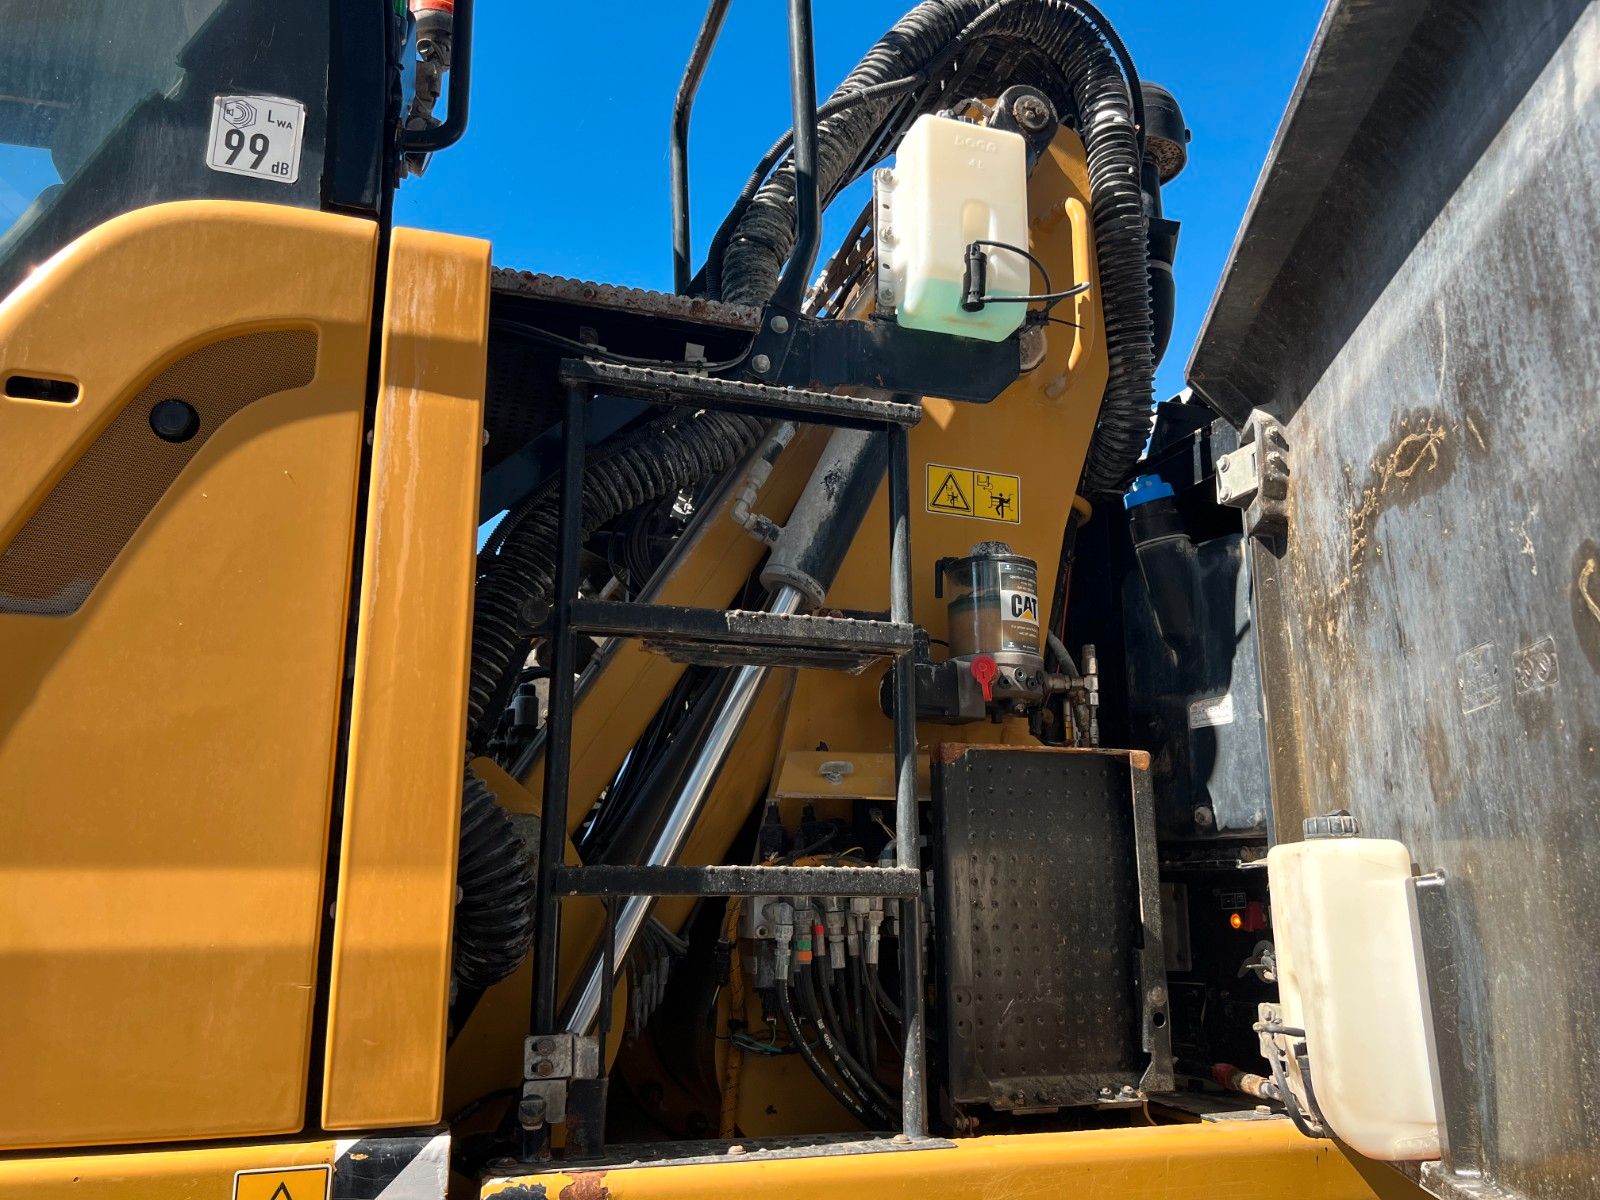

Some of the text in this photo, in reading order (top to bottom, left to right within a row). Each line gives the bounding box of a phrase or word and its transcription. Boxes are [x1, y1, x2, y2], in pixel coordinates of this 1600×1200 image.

[225, 129, 290, 176] 99 dB
[1011, 593, 1038, 622] CAT
